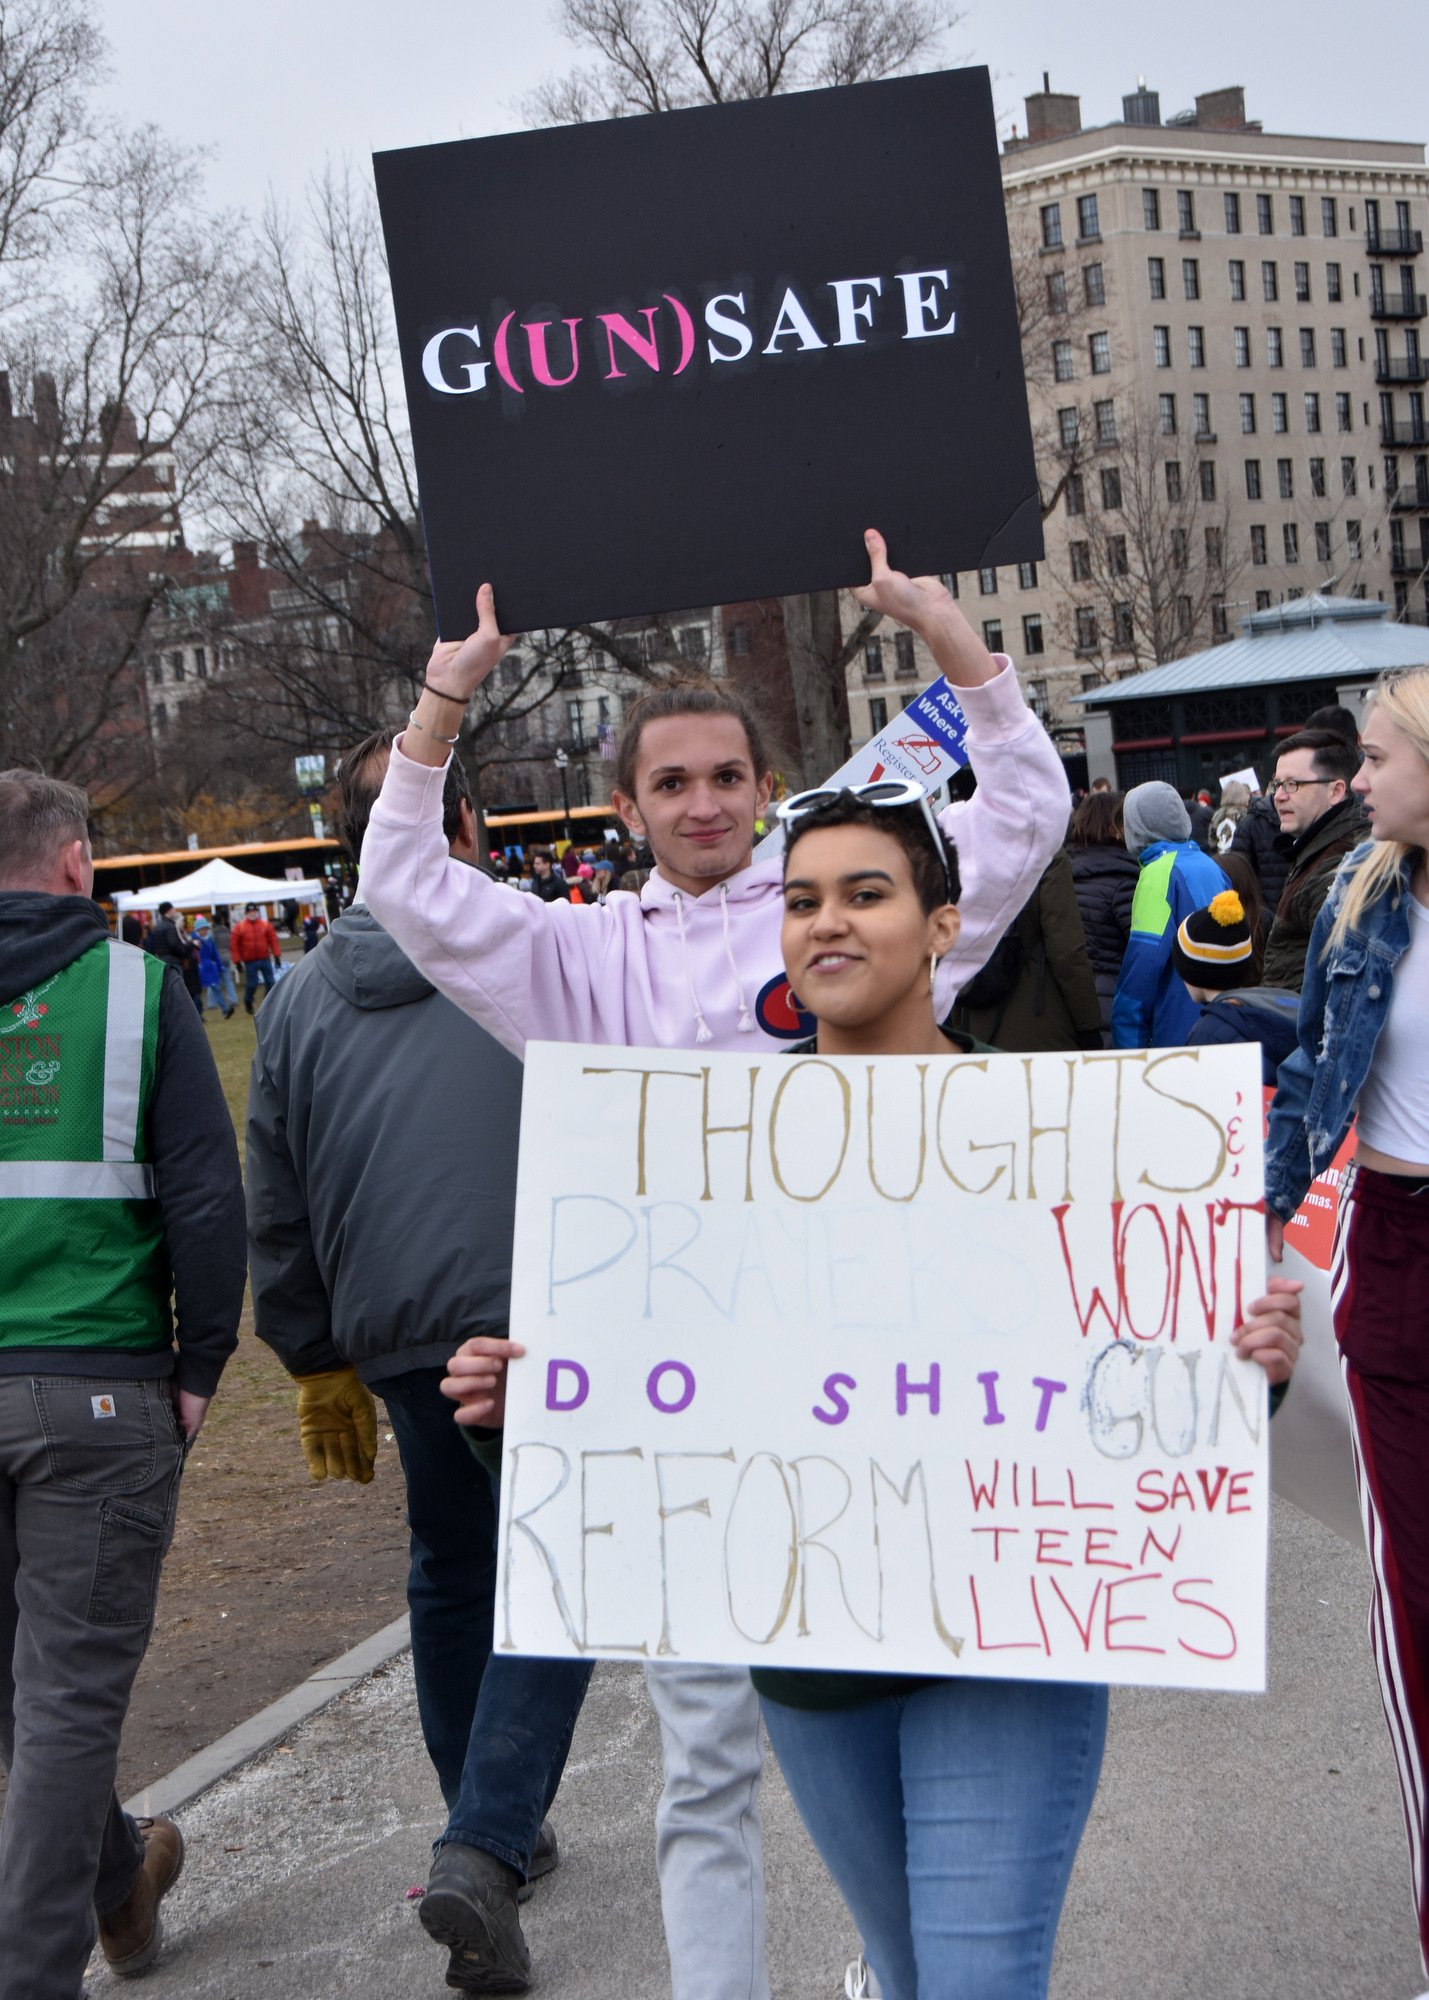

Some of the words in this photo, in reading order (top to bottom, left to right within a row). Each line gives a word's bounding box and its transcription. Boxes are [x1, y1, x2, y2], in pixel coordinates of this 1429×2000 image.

[421, 269, 956, 395] G(UN)SAFE
[918, 697, 958, 739] Where
[936, 692, 962, 718] Ask
[874, 738, 917, 780] Register
[0, 1085, 60, 1106] EATION
[26, 1061, 60, 1085] &
[583, 1051, 1227, 1202] THOUGHTS
[546, 1359, 696, 1415] DO
[812, 1362, 1067, 1432] SHIT
[1081, 1338, 1264, 1460] GUN
[500, 1442, 965, 1658] REFORM
[965, 1459, 1114, 1512] WILL
[1135, 1466, 1255, 1514] SAVE
[971, 1524, 1182, 1570] TEEN
[969, 1572, 1238, 1661] LIVES
